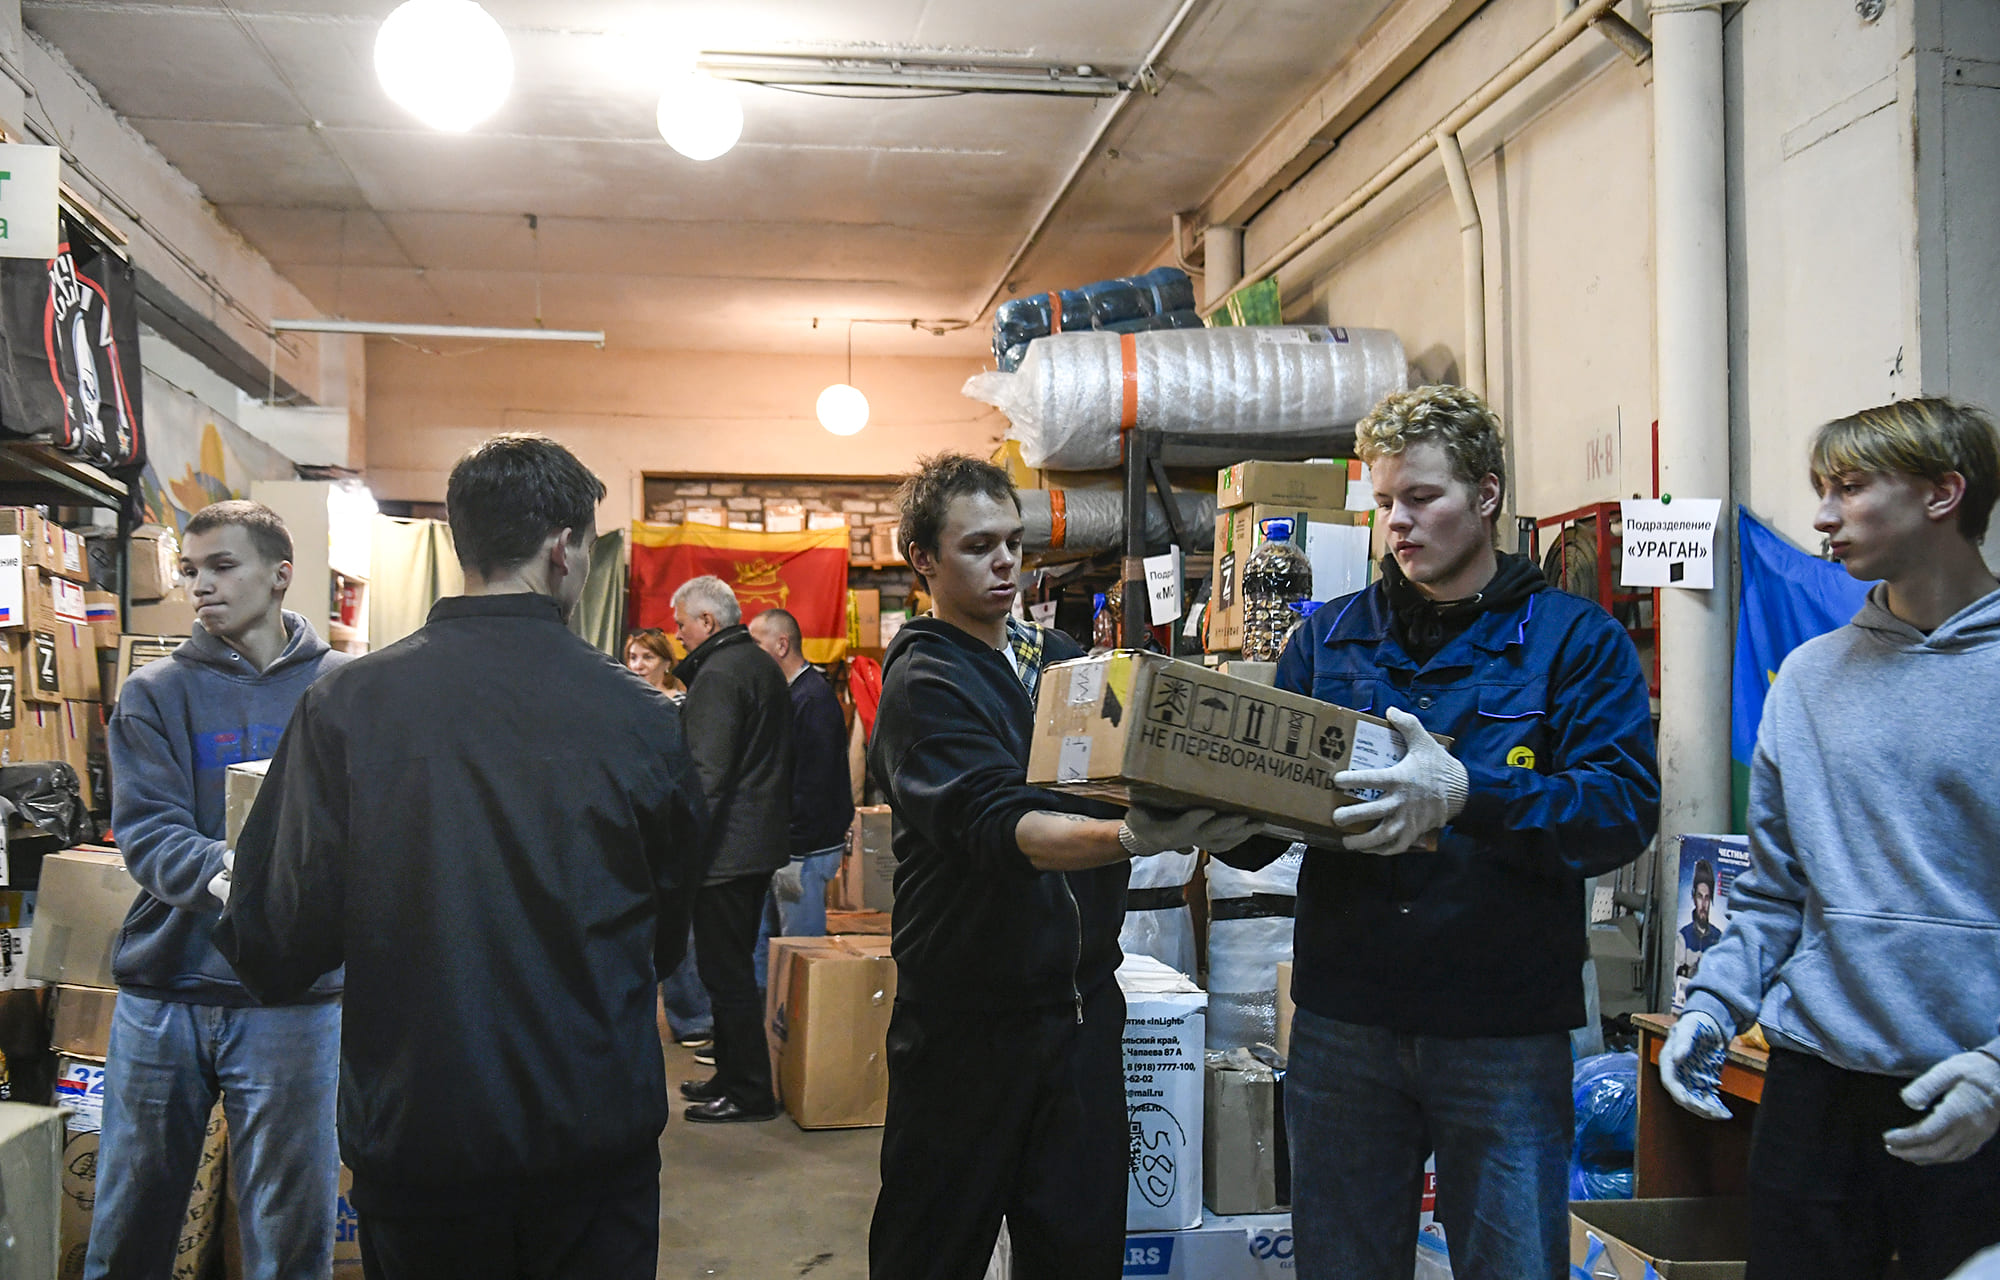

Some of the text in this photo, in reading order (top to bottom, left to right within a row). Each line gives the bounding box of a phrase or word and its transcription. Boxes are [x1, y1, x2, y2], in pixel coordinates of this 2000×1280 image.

[1627, 518, 1712, 533] Подразделение
[1628, 541, 1708, 558] «УРАГАН»
[1223, 567, 1232, 597] Z
[39, 647, 54, 676] Z
[1140, 724, 1168, 749] НЕ
[1157, 1036, 1180, 1046] край,
[1127, 1048, 1163, 1056] Чапаева
[1164, 1048, 1175, 1056] 87
[1134, 1063, 1156, 1072] (918)
[1157, 1062, 1197, 1072] 7777-100,
[1123, 1246, 1161, 1266] RS
